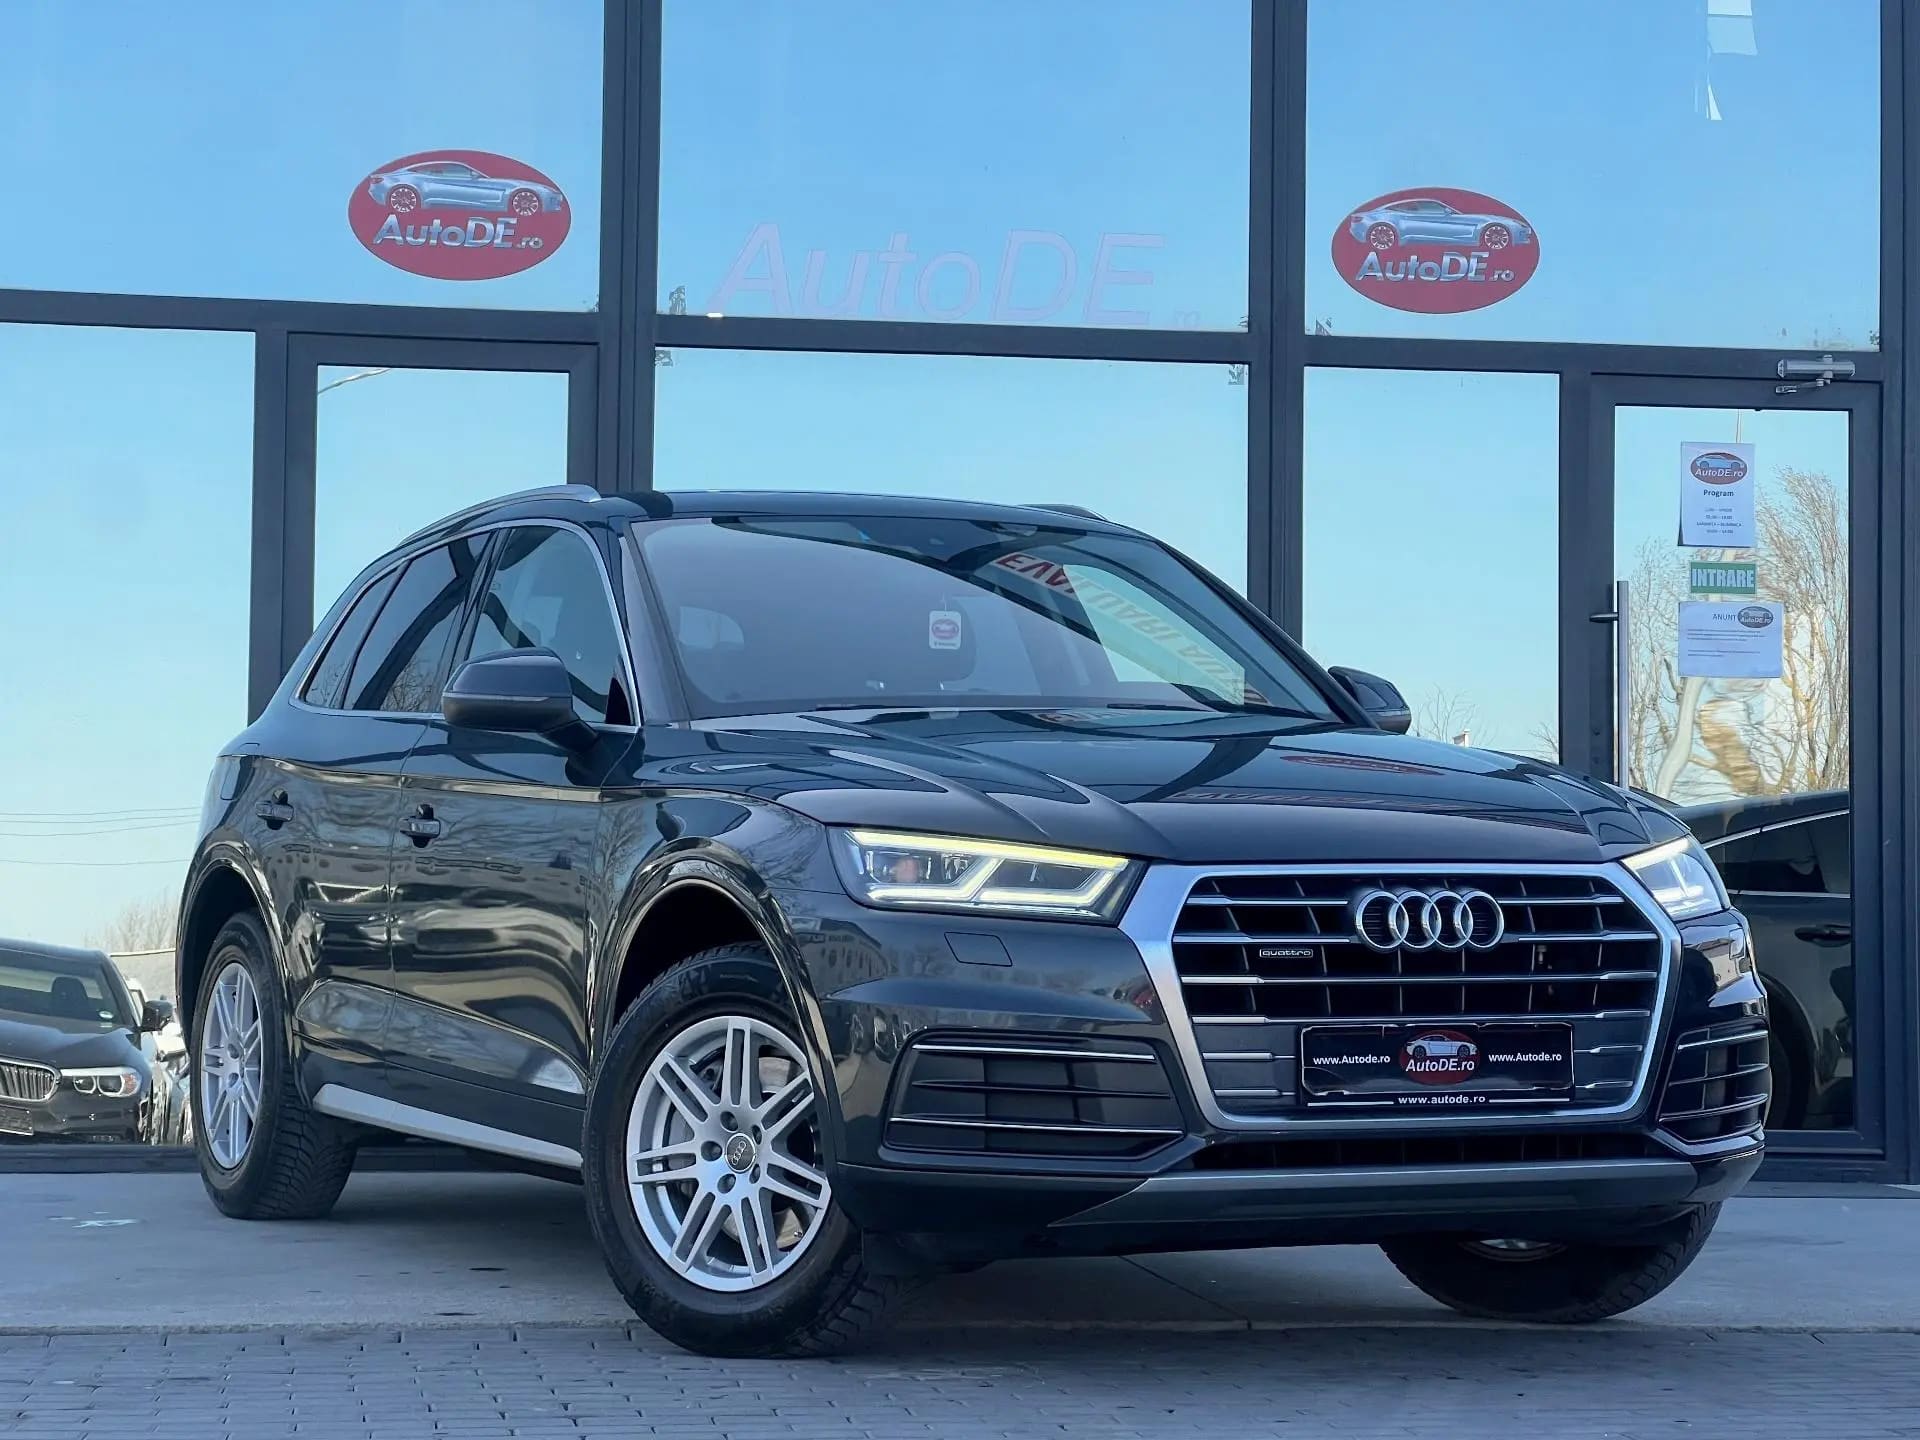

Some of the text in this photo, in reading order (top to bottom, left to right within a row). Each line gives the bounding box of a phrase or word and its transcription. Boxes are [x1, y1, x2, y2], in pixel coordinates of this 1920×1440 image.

[1695, 468, 1744, 478] AutoDE.ro
[1703, 489, 1735, 498] Program
[1692, 568, 1755, 588] INTRARE
[1261, 949, 1312, 957] quattro
[1313, 1053, 1391, 1065] www.Autode.ro
[1488, 1052, 1563, 1063] www.Autode.ro
[1405, 1058, 1475, 1072] AutoDE.ro
[1398, 1094, 1486, 1105] www.autode.ro
